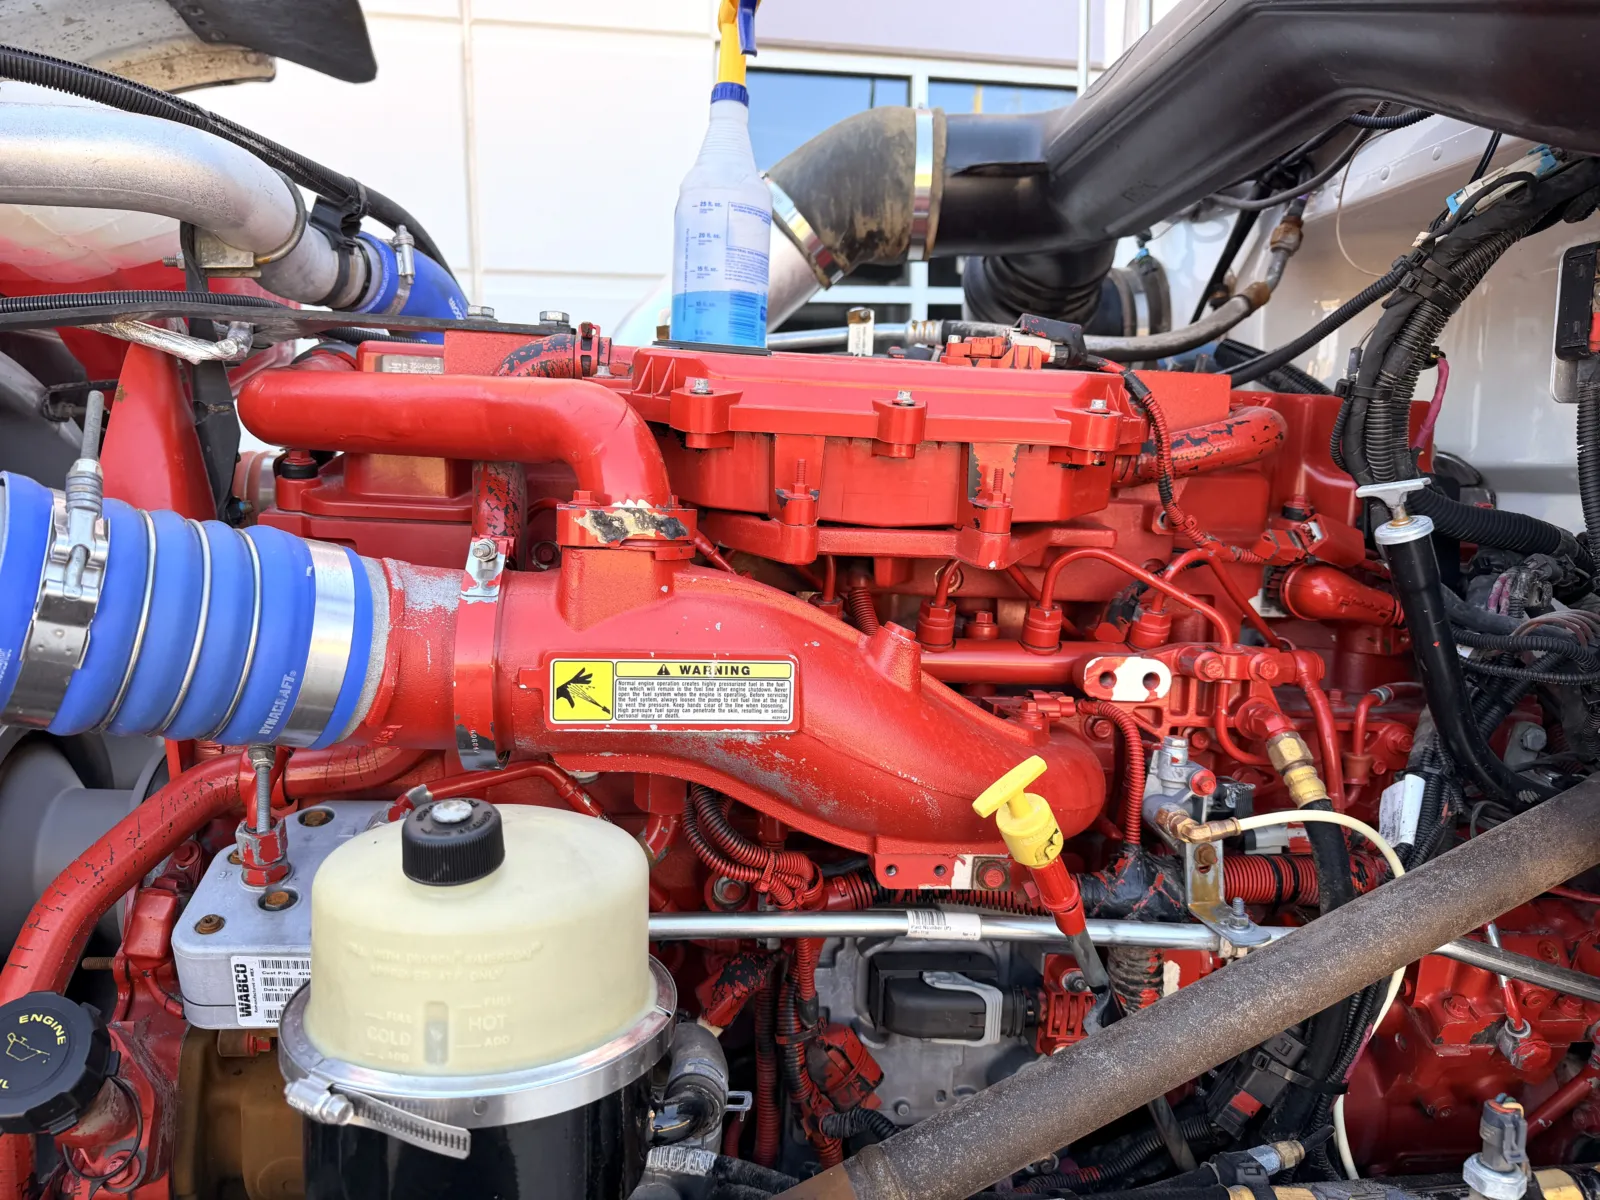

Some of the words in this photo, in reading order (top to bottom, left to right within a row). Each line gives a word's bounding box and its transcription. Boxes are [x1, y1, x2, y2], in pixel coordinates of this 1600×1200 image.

[680, 665, 750, 676] WARNING
[234, 964, 252, 1017] WABCO
[18, 1014, 66, 1046] ENGINE
[468, 1013, 508, 1032] HOT
[366, 1025, 411, 1046] COLD
